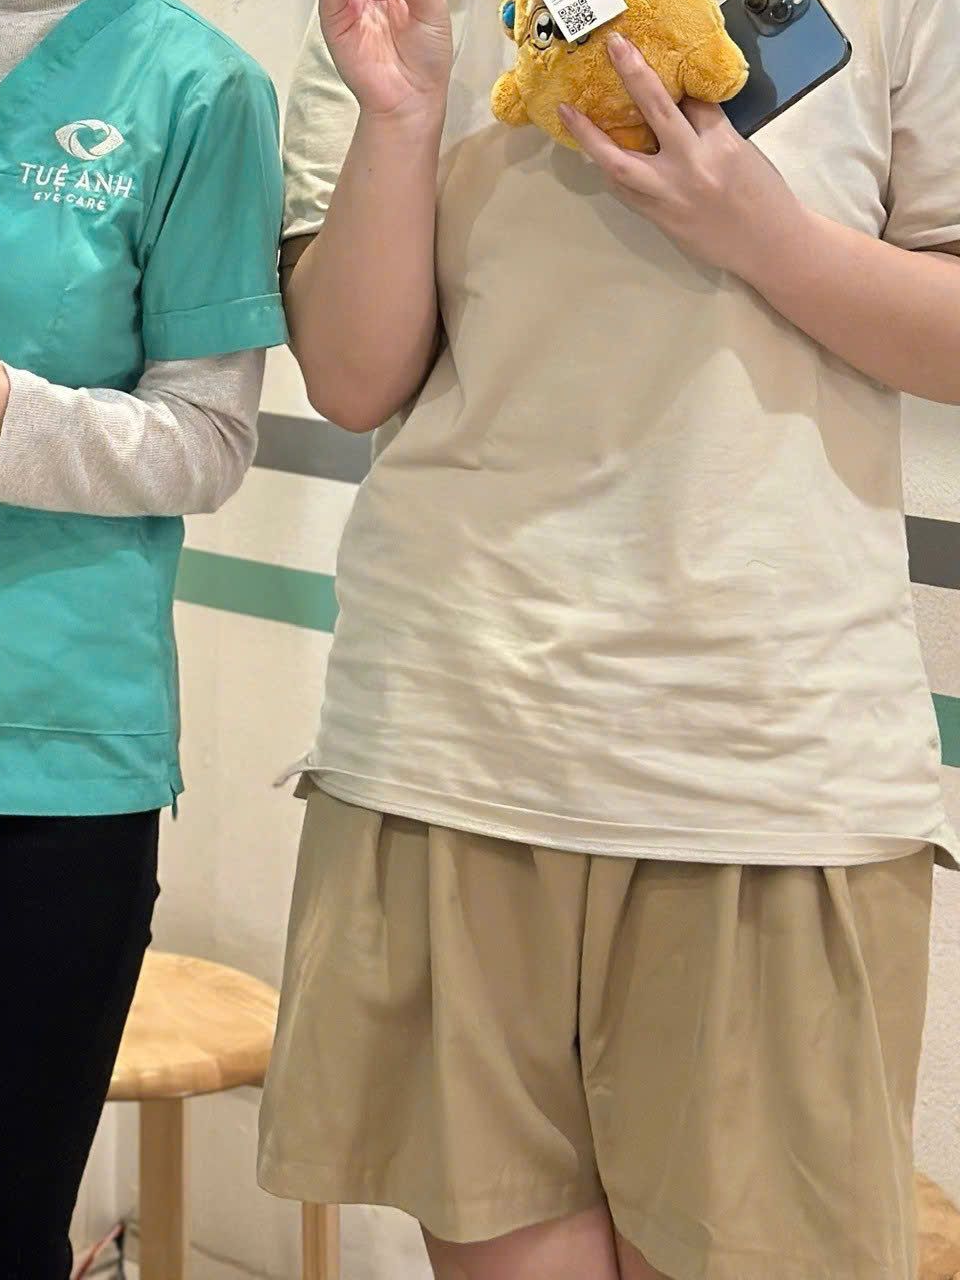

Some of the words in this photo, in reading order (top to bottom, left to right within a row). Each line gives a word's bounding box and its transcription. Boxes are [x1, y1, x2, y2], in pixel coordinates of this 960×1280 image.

[20, 163, 69, 192] TUỆ
[74, 169, 133, 198] ANH
[34, 191, 61, 203] EYE
[65, 193, 106, 211] CARE
